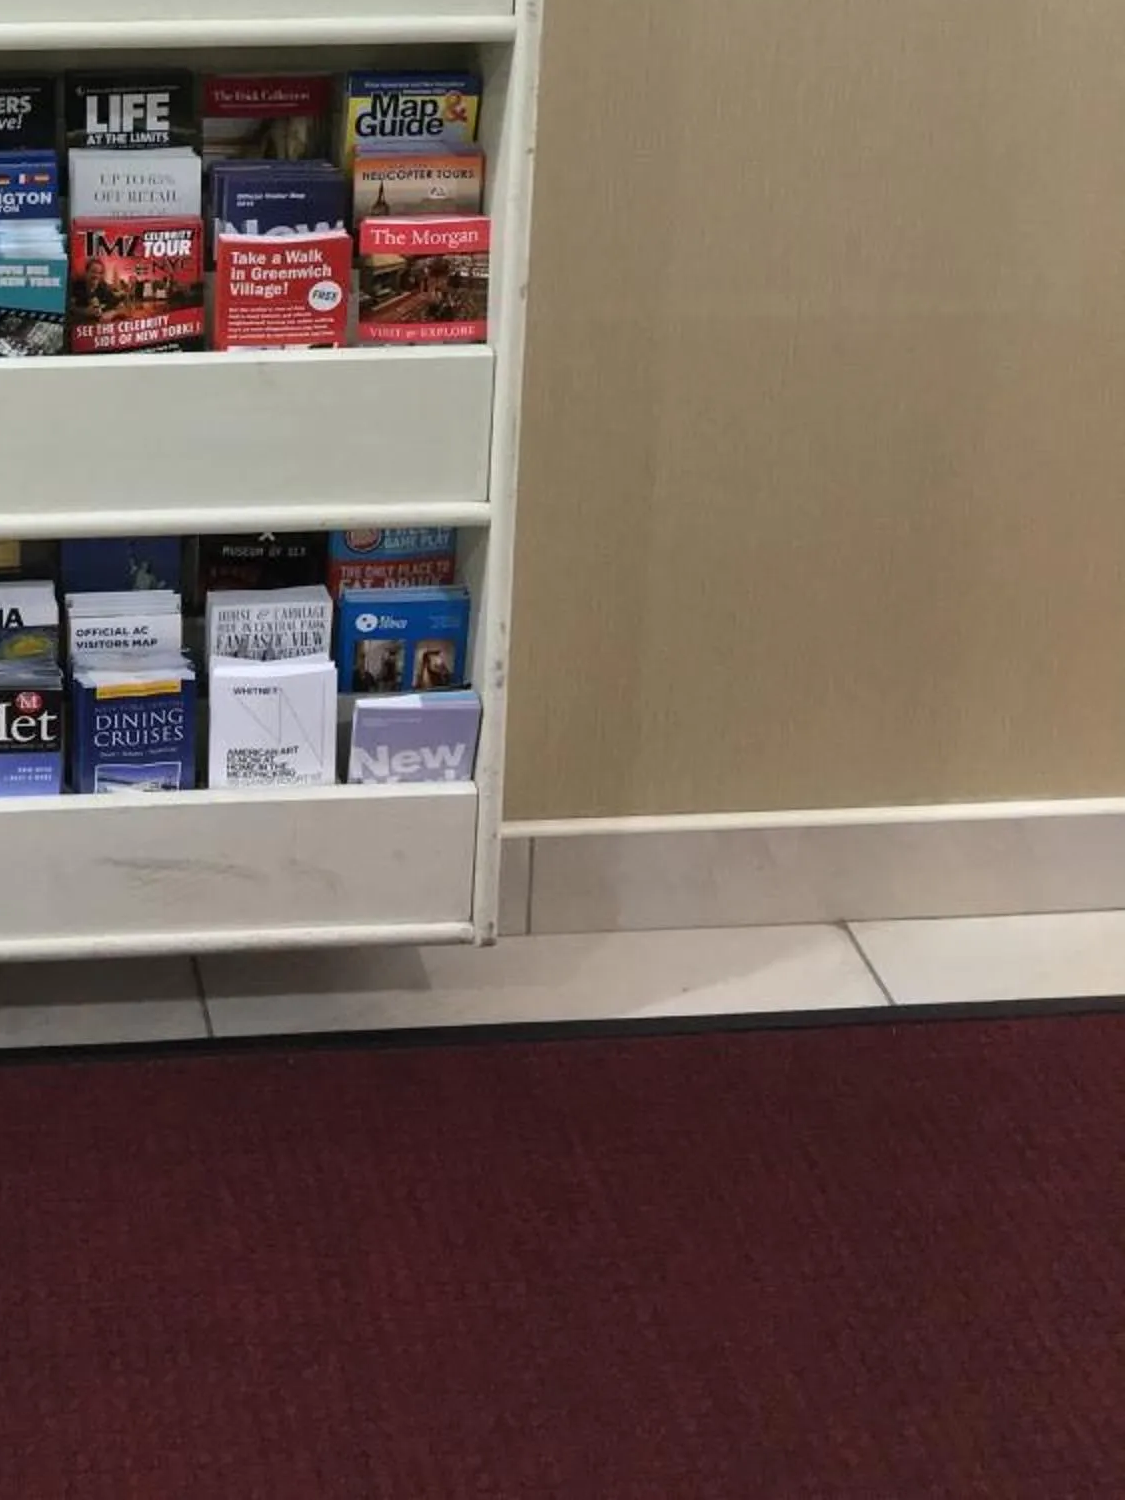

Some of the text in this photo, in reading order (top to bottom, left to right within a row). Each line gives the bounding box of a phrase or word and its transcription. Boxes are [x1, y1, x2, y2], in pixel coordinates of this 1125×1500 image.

[214, 91, 234, 101] The
[86, 93, 170, 133] LIFE
[371, 92, 438, 122] Map
[355, 112, 444, 137] Guide
[87, 132, 169, 144] AT THE LIMITS
[100, 174, 122, 184] UP
[362, 169, 475, 181] HELICOPTER TOURS
[94, 190, 177, 202] OFF RETAIL
[78, 230, 192, 257] TMZ CELEBRITY
[370, 228, 480, 249] The Morgan
[143, 240, 191, 258] TOUR
[231, 249, 323, 265] Take a Walk
[251, 264, 332, 281] Greenwich
[230, 282, 288, 298] Village!
[77, 315, 170, 337] SEE THE CELEBRITY
[370, 326, 476, 337] VISIT EXPLORE
[94, 330, 157, 348] SIDE OF NEW
[223, 548, 263, 557] MUSEUM
[218, 609, 251, 621] HORSE
[75, 627, 148, 637] OFFICIAL AC
[292, 632, 322, 646] VIEW
[75, 639, 158, 649] VISITORS MAP
[234, 687, 278, 695] WHITNEY
[96, 708, 184, 730] DINING
[94, 726, 184, 747] CRUISES
[281, 745, 299, 754] ART
[348, 743, 466, 777] New
